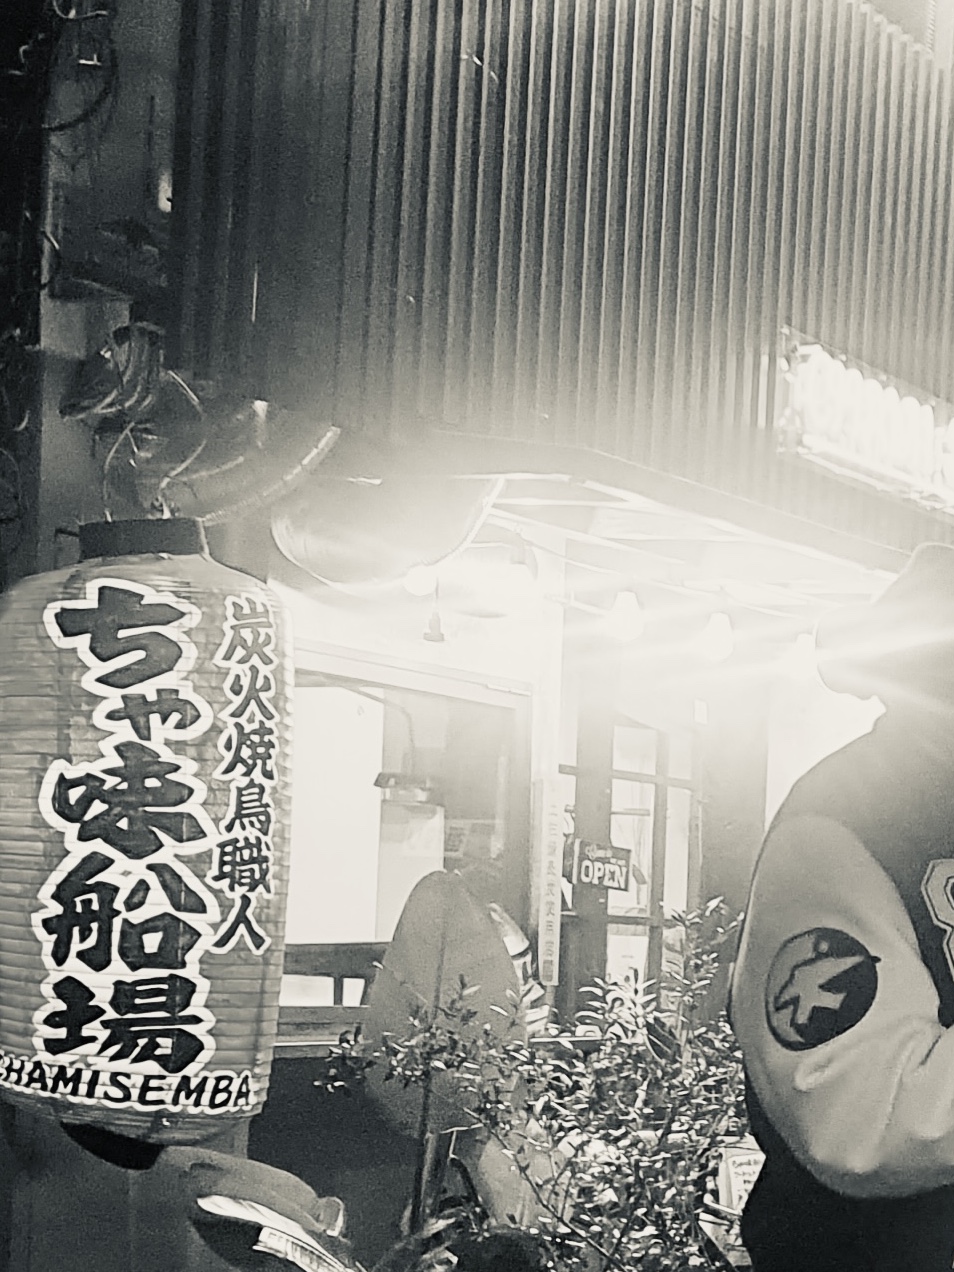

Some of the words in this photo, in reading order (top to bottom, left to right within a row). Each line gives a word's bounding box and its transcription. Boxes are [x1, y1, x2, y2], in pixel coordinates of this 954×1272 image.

[42, 585, 208, 1075] ちゃ味船場
[212, 599, 277, 952] 炭火焼鳥職人
[580, 858, 627, 889] OPEN
[0, 1053, 251, 1109] HAMISEMBA
